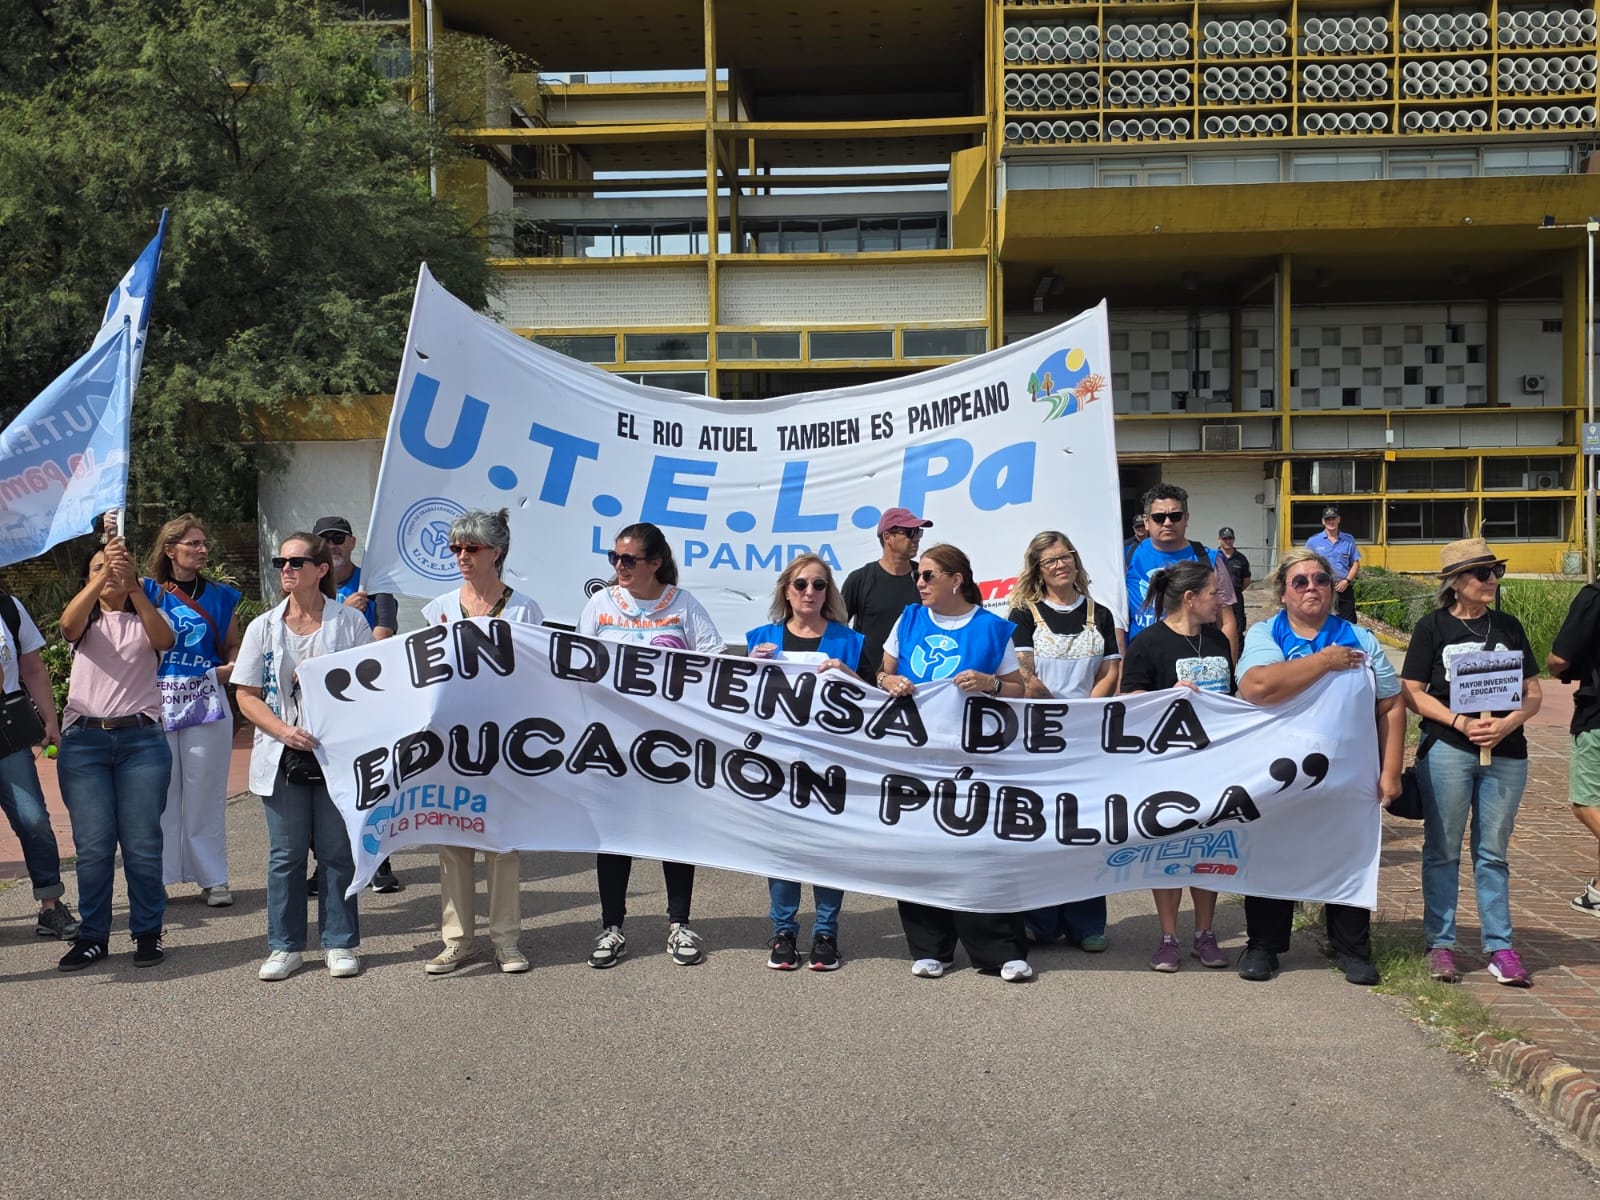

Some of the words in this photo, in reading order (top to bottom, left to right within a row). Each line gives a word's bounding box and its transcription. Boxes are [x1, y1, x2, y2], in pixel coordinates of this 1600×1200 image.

[617, 412, 639, 440] EL
[653, 420, 682, 447] RIO
[699, 426, 757, 452] ATUEL
[777, 417, 860, 451] TAMBIEN
[871, 411, 893, 440] ES
[908, 381, 1010, 434] PAMPEANO
[592, 526, 608, 555] L
[412, 548, 458, 571] U.T.E.L.P
[157, 681, 187, 691] FENSA
[550, 632, 928, 746] DEFENSA
[961, 696, 1069, 754] DE
[1101, 699, 1211, 754] LA
[1459, 681, 1482, 689] MAYOR
[1484, 676, 1519, 686] INVERSIÓN
[1471, 686, 1508, 696] EDUCATIVA
[353, 718, 847, 815] EDUCACIÓN
[391, 784, 487, 814] UTELPa
[415, 811, 485, 834] pampa
[1106, 830, 1240, 867] CTERA
